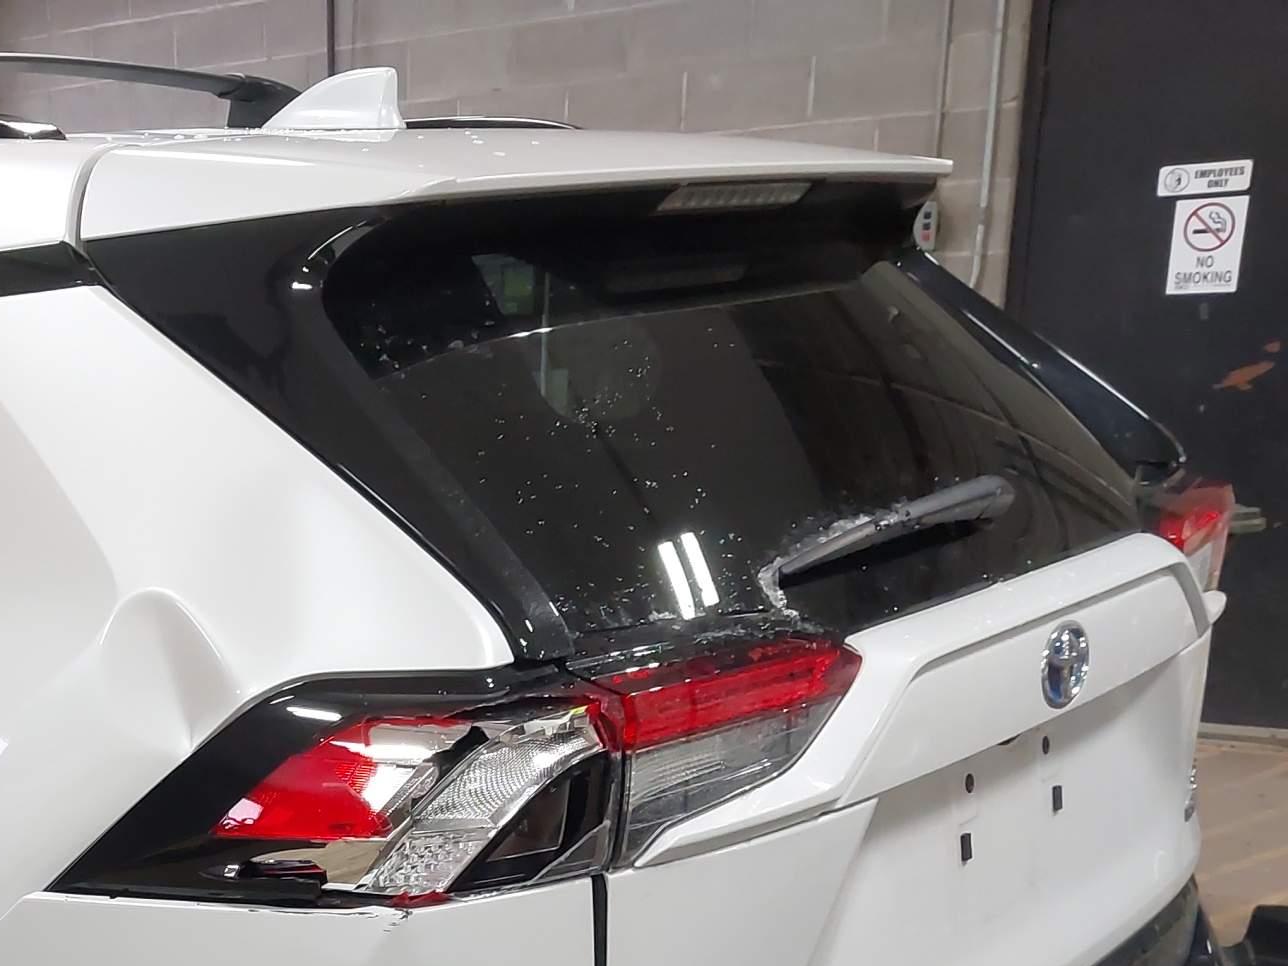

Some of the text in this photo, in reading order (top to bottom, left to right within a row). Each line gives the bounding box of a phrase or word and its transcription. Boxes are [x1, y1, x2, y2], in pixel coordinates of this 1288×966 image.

[1194, 166, 1245, 179] EMPLOYEES
[1207, 178, 1230, 188] ONLY
[1195, 254, 1215, 269] NO
[1174, 269, 1233, 285] SMOKING
